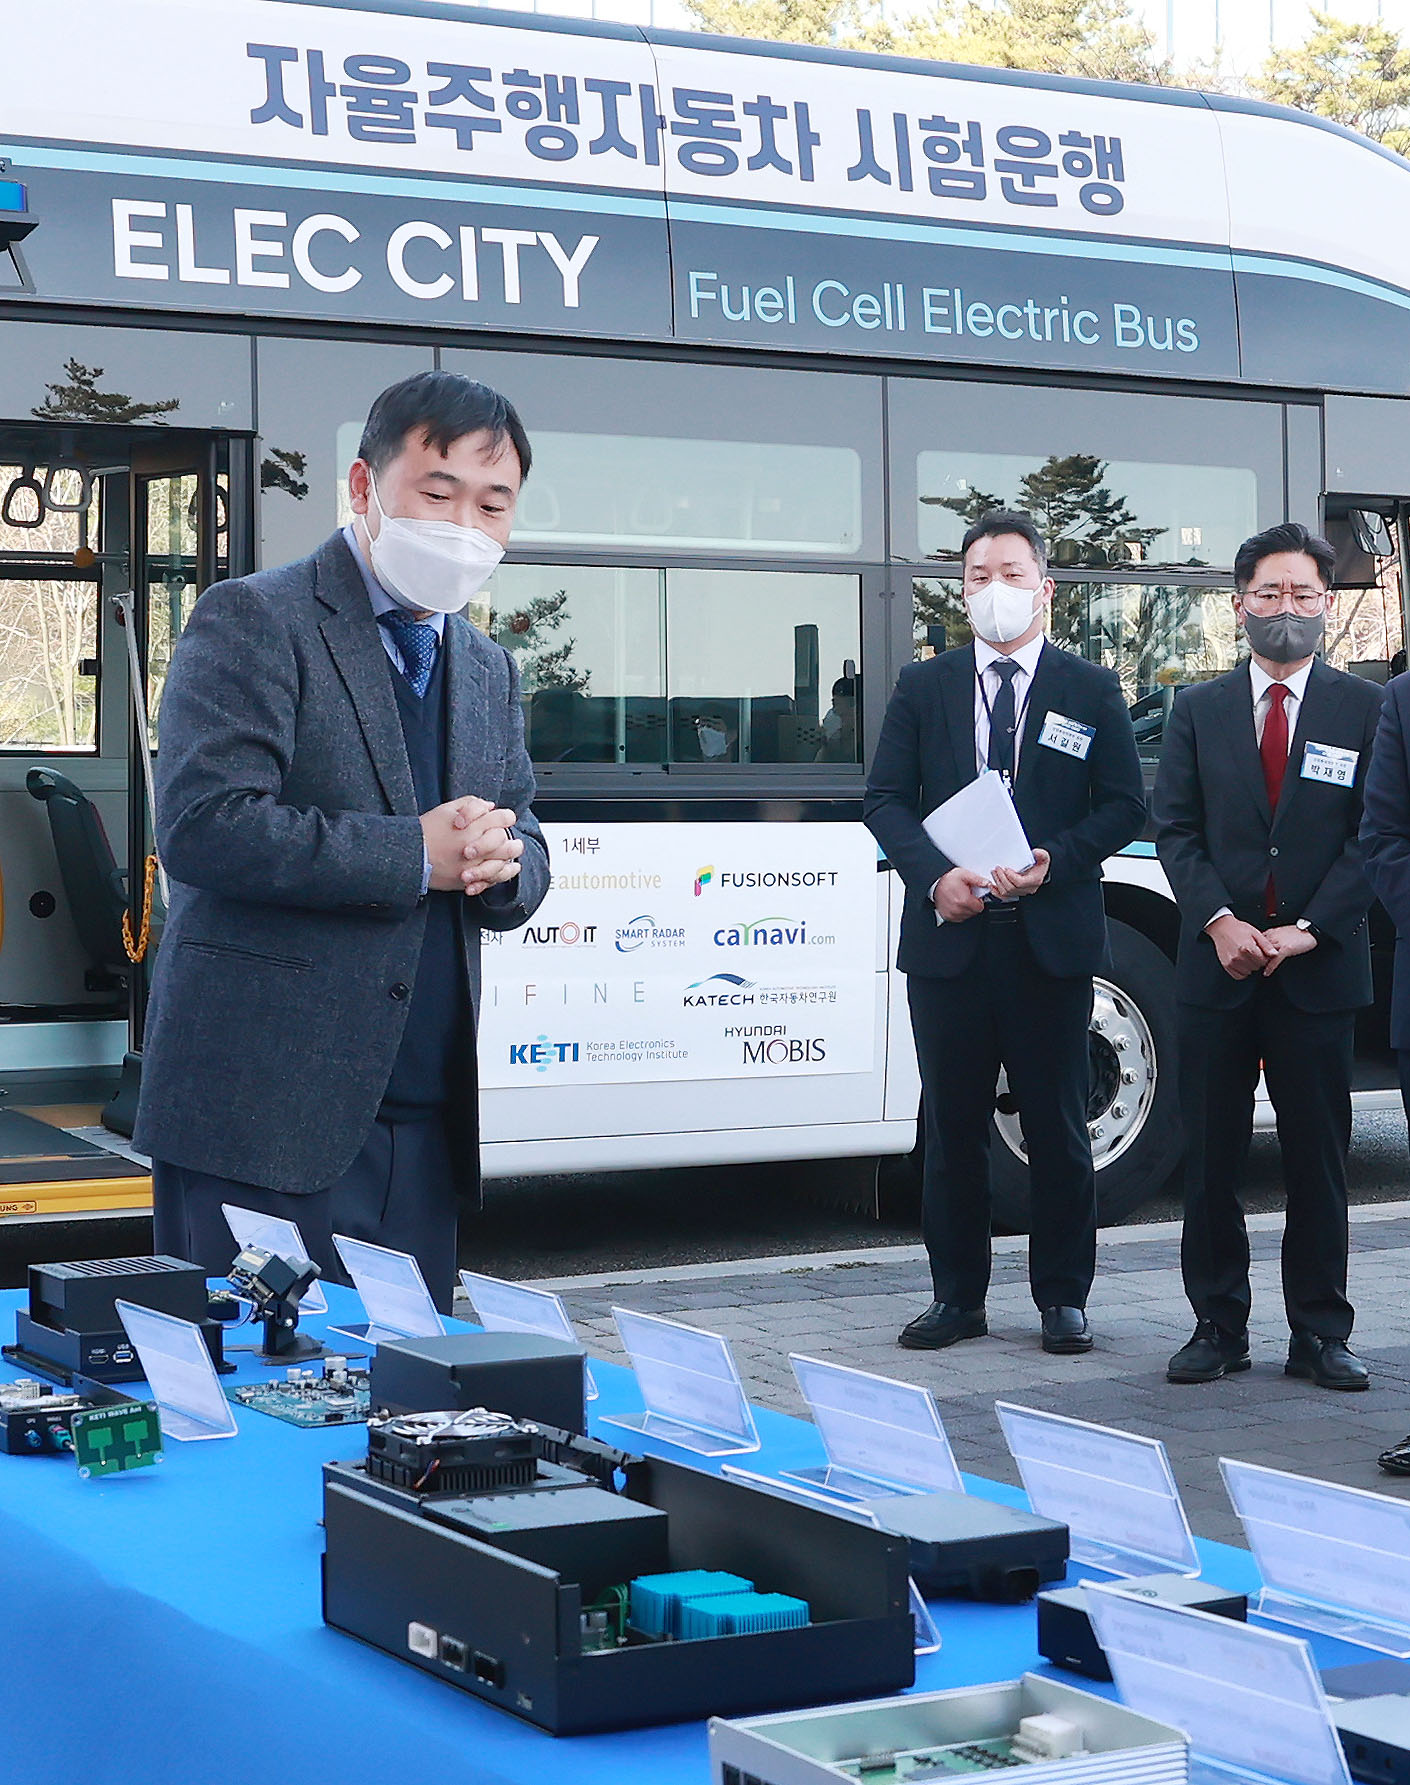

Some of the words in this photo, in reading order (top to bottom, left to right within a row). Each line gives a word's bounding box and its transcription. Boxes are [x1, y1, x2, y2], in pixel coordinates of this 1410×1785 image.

[246, 42, 820, 182] 자율주행자동차
[847, 108, 1125, 216] 시험운행
[111, 198, 363, 293] ELEC
[386, 220, 600, 308] CITY
[689, 271, 795, 324] Fuel
[812, 280, 904, 331] Cell
[923, 287, 1100, 345] Electric
[1114, 304, 1199, 352] Bus
[562, 837, 601, 855] 1세부
[559, 867, 662, 890] automotive
[721, 872, 838, 888] FUSIONSOFT
[615, 929, 650, 940] SMART
[652, 928, 686, 938] RADAR
[651, 940, 686, 948] SYSTEM
[683, 994, 755, 1008] KATECH
[760, 990, 837, 1005] 한국자동차연구원
[724, 1025, 787, 1038] HYUNDAI
[509, 1042, 580, 1065] KETI
[586, 1042, 616, 1052] Korea
[619, 1039, 676, 1050] Electronics
[743, 1038, 826, 1065] MOBIS
[586, 1051, 643, 1062] Technology
[646, 1049, 689, 1060] Institute
